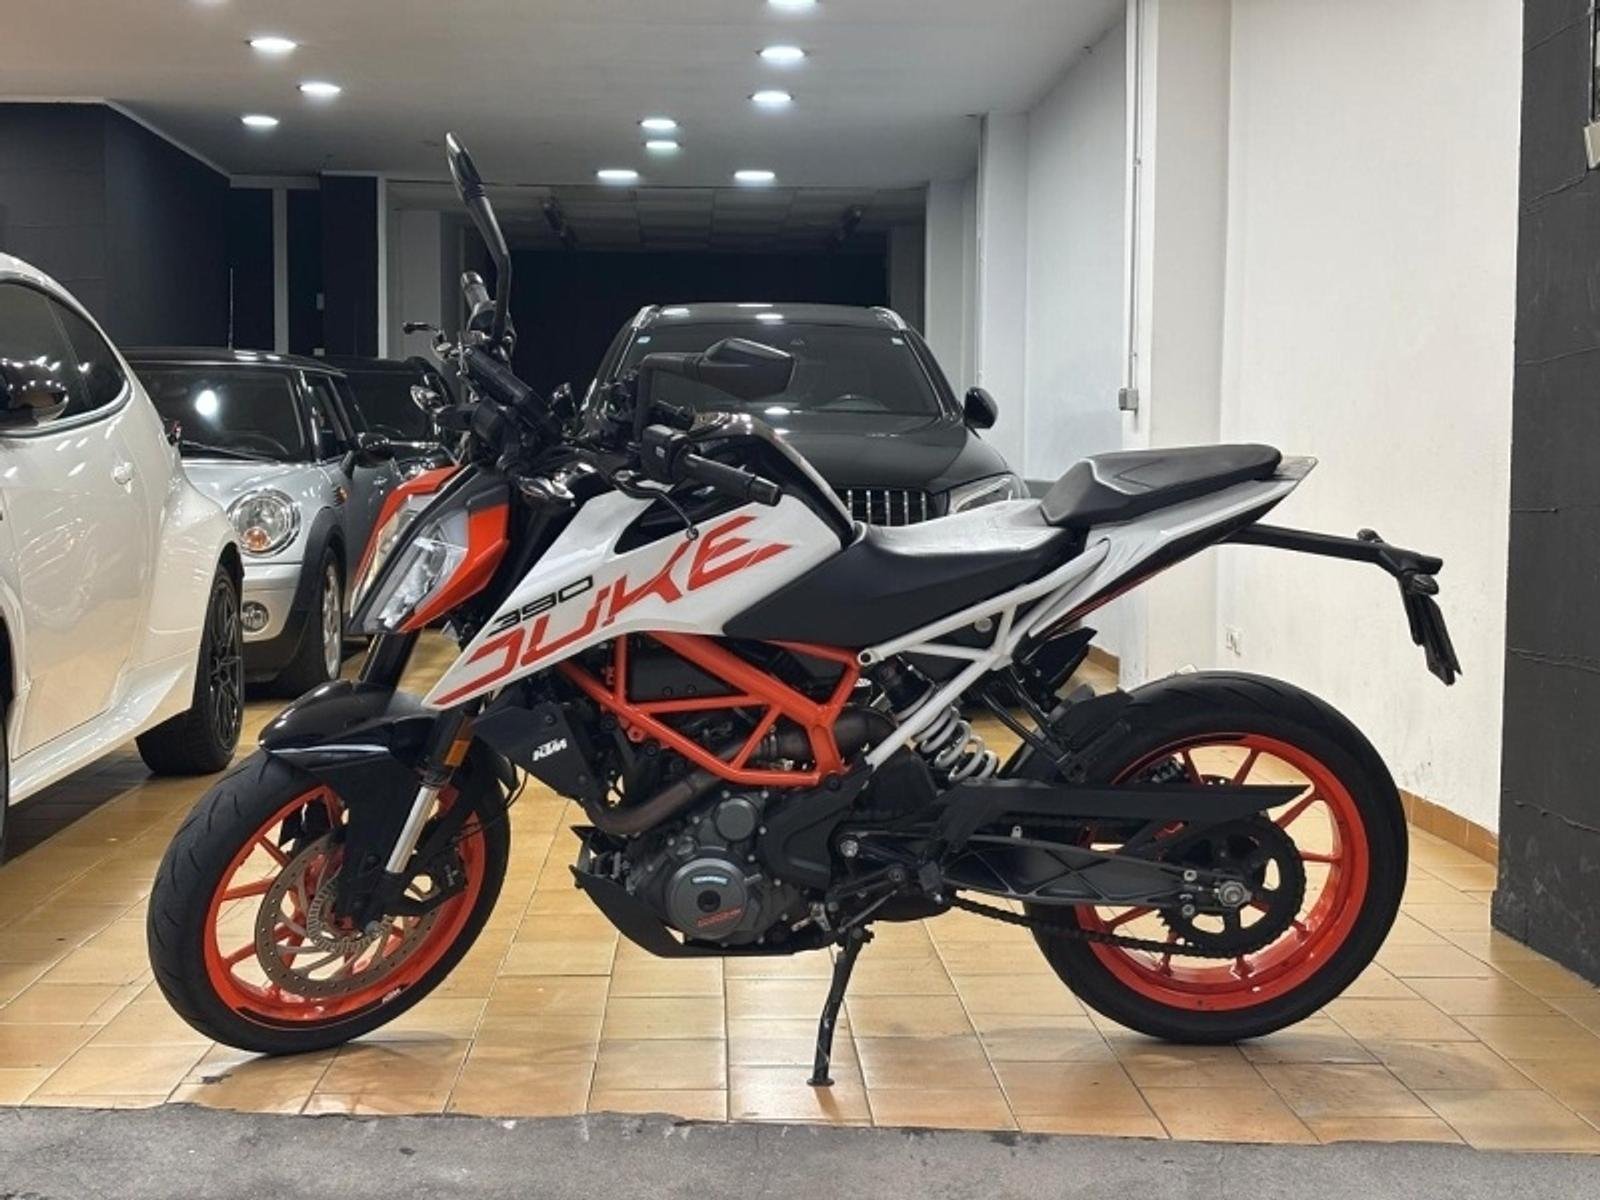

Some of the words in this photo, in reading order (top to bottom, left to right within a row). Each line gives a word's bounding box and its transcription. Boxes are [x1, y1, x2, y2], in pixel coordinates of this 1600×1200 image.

[432, 516, 792, 705] DUKE
[486, 575, 593, 637] 390
[532, 738, 568, 761] KTM
